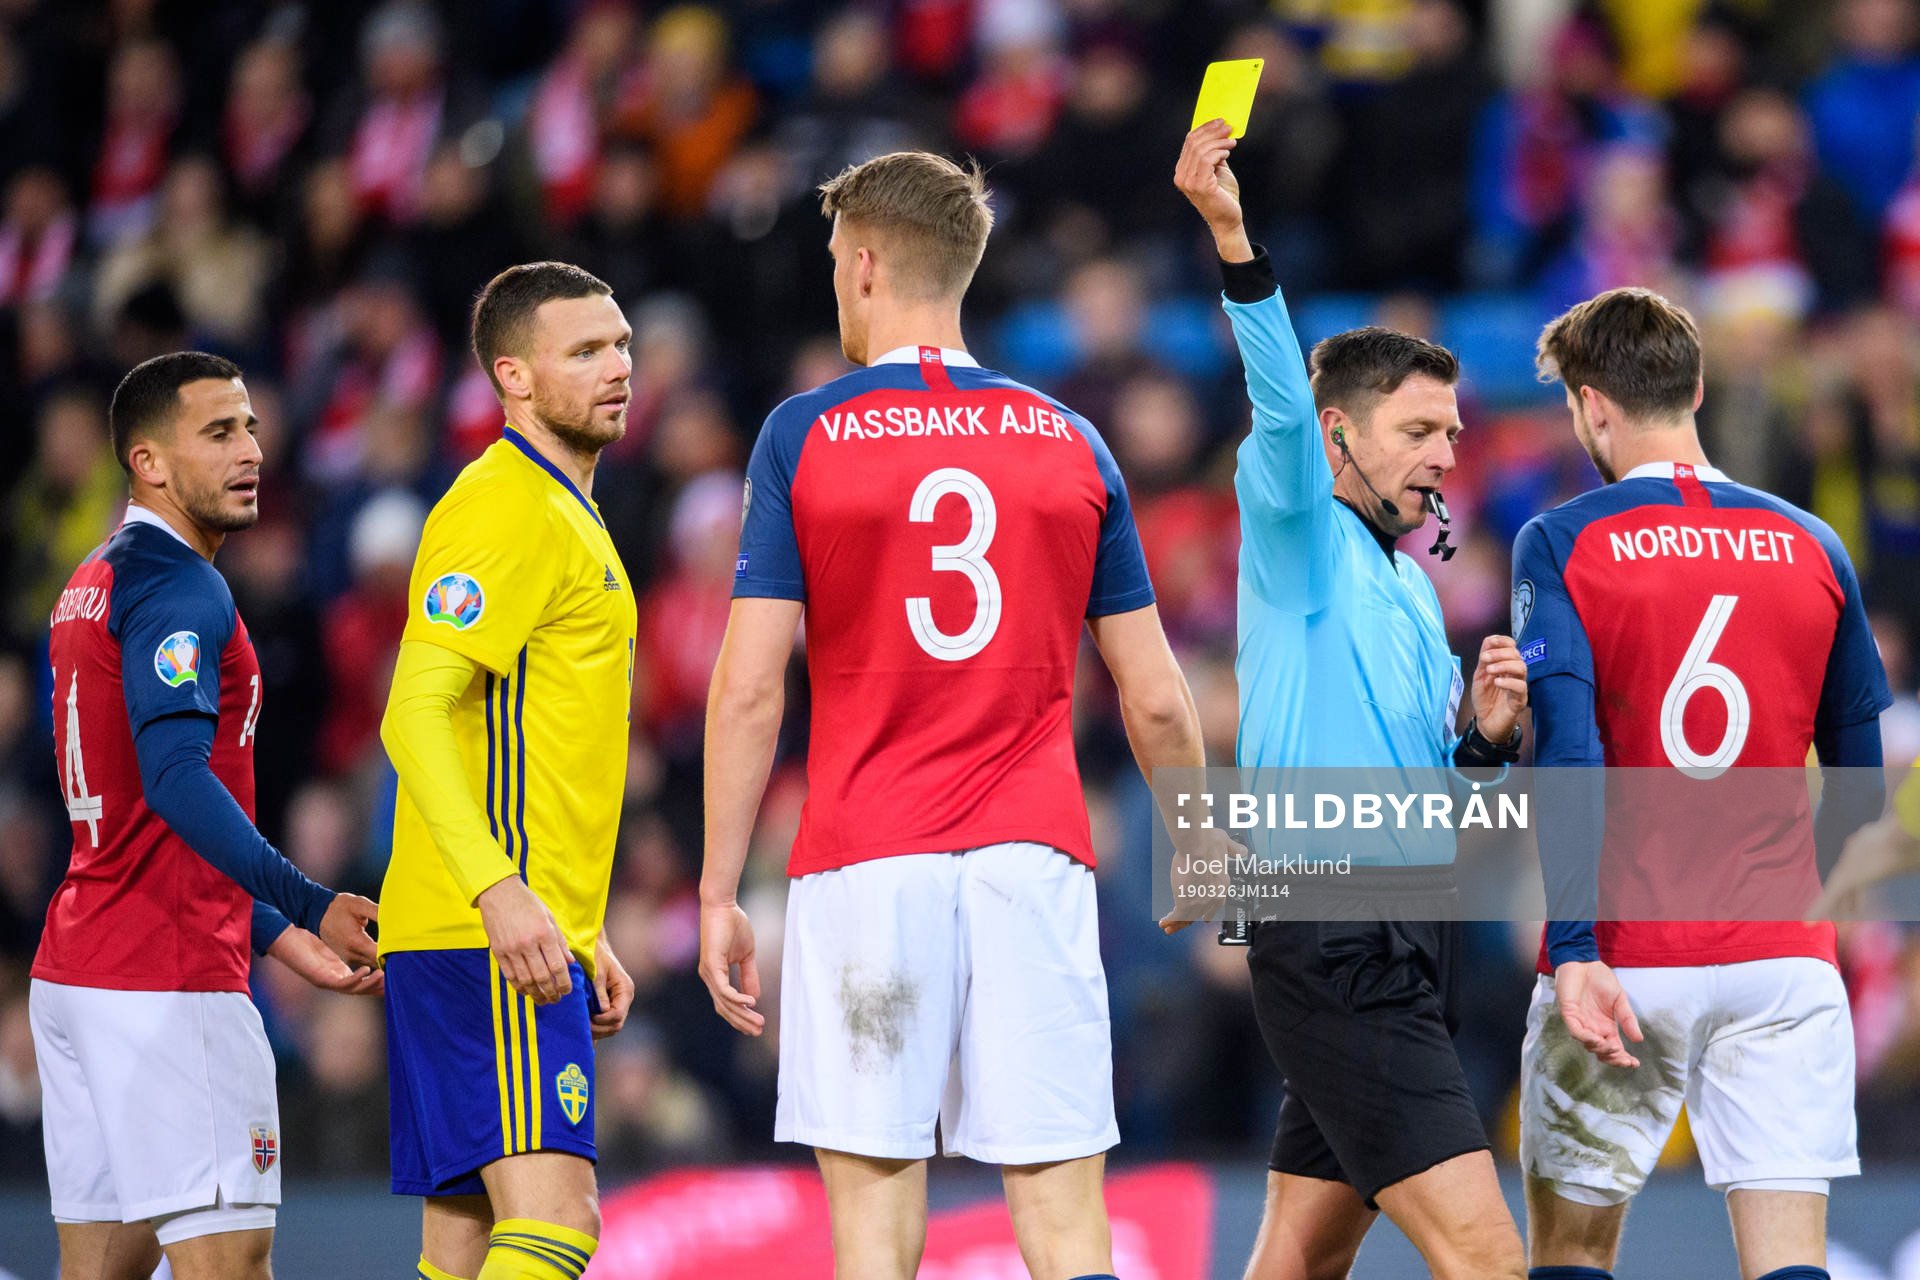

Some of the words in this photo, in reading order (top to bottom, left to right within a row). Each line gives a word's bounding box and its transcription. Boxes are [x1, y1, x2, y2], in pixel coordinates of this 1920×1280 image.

[819, 406, 990, 442] VASSBAKK
[999, 404, 1074, 442] AJER
[905, 467, 1002, 662] 3
[1609, 525, 1795, 564] NORDTVEIT
[1659, 594, 1751, 780] 6
